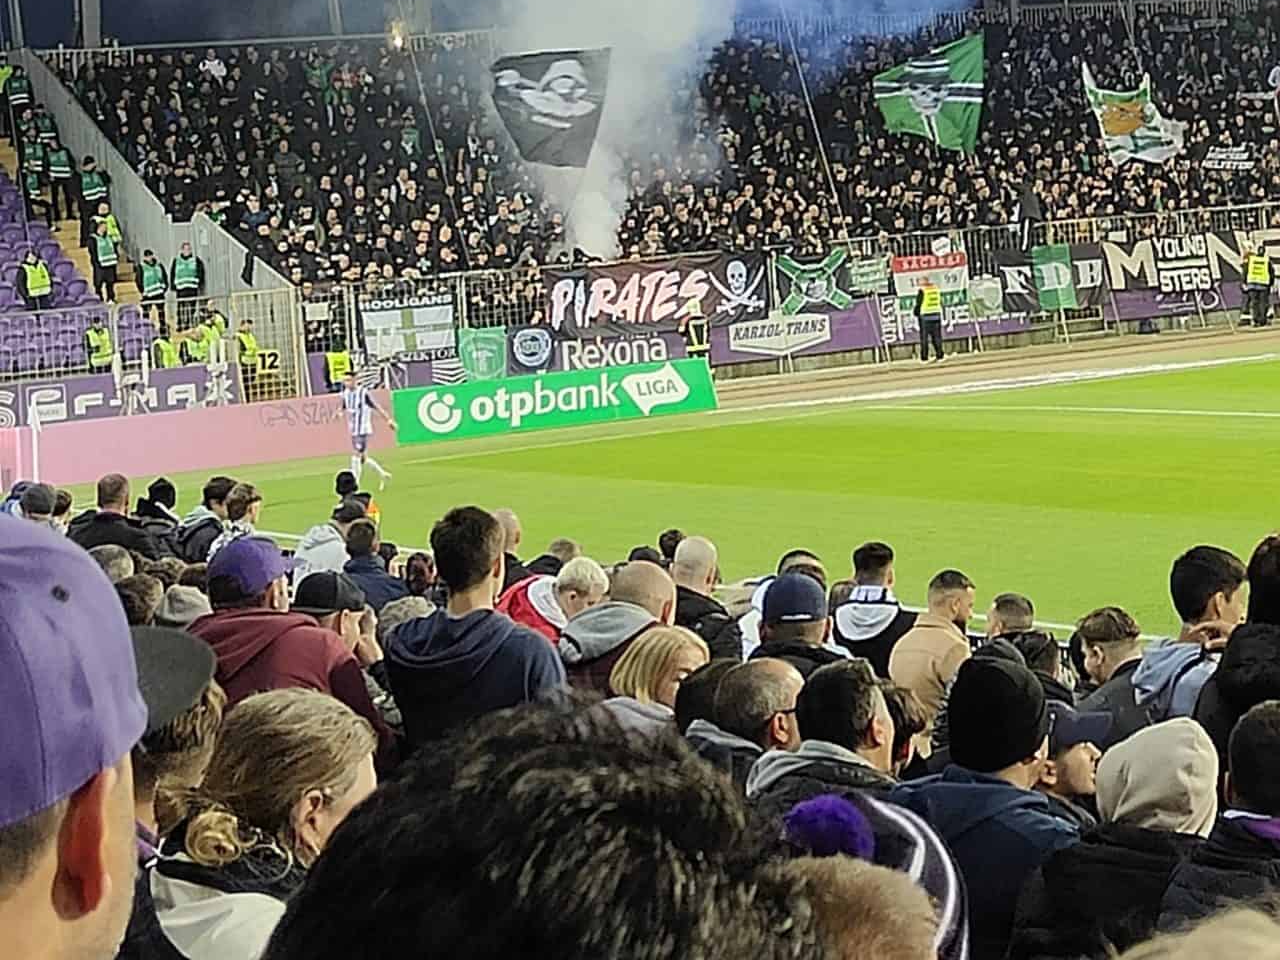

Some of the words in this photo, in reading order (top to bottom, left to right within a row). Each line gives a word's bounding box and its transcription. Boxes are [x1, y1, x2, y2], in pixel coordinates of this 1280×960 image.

[1153, 233, 1206, 259] YOUNG
[1159, 268, 1212, 292] STERS
[551, 268, 710, 331] PIRATES
[257, 351, 280, 370] 12
[561, 337, 667, 371] Rexona
[469, 373, 621, 428] otpbank
[637, 379, 679, 397] LIGA
